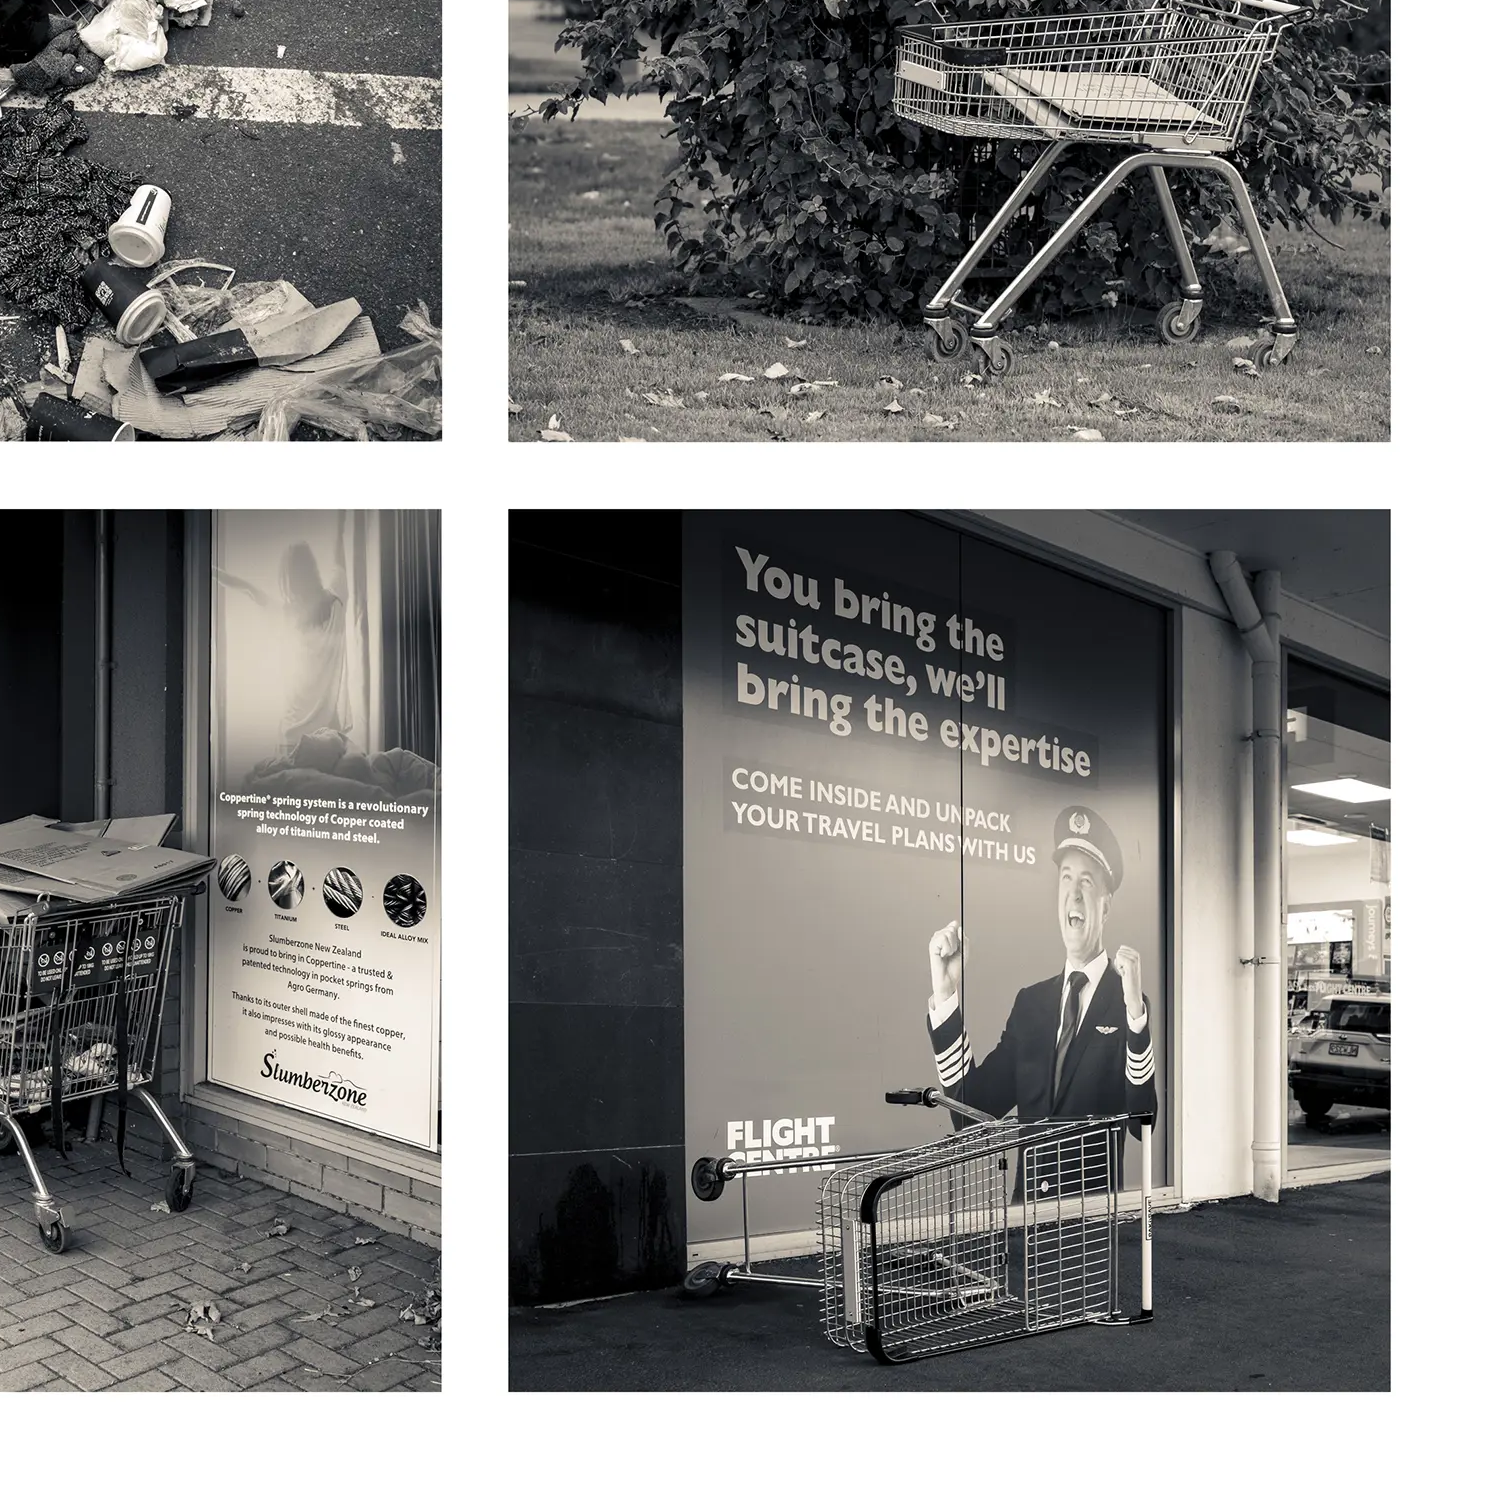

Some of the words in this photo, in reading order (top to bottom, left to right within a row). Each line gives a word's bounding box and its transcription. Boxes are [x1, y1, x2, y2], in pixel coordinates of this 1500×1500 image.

[734, 545, 821, 610] You
[833, 577, 937, 653] bring
[945, 612, 1004, 661] the
[735, 613, 918, 697] suitcase,
[737, 661, 853, 737] bring
[863, 694, 929, 742] the
[939, 718, 1091, 777] expertise
[272, 795, 301, 809] spring
[302, 798, 337, 810] system
[338, 798, 347, 809] is
[348, 801, 354, 810] a
[356, 800, 429, 818] revolutionary
[731, 767, 802, 799] COME
[809, 780, 881, 812] INSIDE
[885, 793, 930, 819] AND
[935, 802, 1012, 833] UNPACK
[237, 808, 265, 821] spring
[266, 810, 317, 825] technology
[318, 813, 329, 824] of
[330, 814, 366, 829] Copper
[368, 818, 405, 830] coated
[256, 824, 279, 836] alloy
[279, 825, 289, 836] of
[290, 826, 330, 840] titanium
[332, 830, 351, 842] and
[352, 832, 380, 844] steel.
[731, 801, 800, 832] YOUR
[802, 811, 886, 844] TRAVEL
[892, 825, 955, 854] PLANS
[957, 835, 1008, 861] WITH
[1013, 845, 1036, 865] US
[225, 906, 243, 914] COPPER
[274, 913, 298, 923] TITANIUM
[334, 923, 350, 931] STEEL
[269, 934, 314, 950] Slumberzone
[314, 943, 331, 953] New
[332, 945, 362, 959] Zealand
[380, 930, 397, 939] IDEAL
[397, 933, 416, 942] ALLOY
[417, 935, 429, 944] MIX
[242, 943, 249, 951] is
[249, 945, 269, 957] proud
[278, 950, 297, 963] bring
[297, 954, 304, 963] in
[305, 955, 346, 971] Coppertine
[357, 966, 386, 979] trusted
[386, 971, 394, 980] &
[242, 958, 271, 971] patented
[272, 964, 311, 980] technology
[311, 971, 319, 979] in
[320, 973, 345, 986] pocket
[346, 978, 373, 993] springs
[375, 983, 394, 996] from
[287, 980, 304, 994] Agro
[305, 985, 340, 1000] Germany.
[232, 991, 254, 1003] Thanks
[255, 997, 262, 1005] to
[263, 998, 272, 1007] its
[272, 1001, 291, 1012] outer
[291, 1004, 308, 1016] shell
[309, 1008, 329, 1022] made
[330, 1014, 338, 1023] of
[339, 1016, 351, 1027] the
[353, 1018, 374, 1033] finest
[375, 1026, 406, 1040] copper,
[242, 1007, 247, 1016] it
[248, 1008, 261, 1019] also
[262, 1012, 295, 1028] impresses
[296, 1021, 312, 1032] with
[312, 1024, 322, 1034] its
[322, 1027, 346, 1042] glossy
[346, 1034, 392, 1052] appearance
[264, 1027, 278, 1037] and
[278, 1031, 307, 1046] possible
[307, 1037, 331, 1051] health
[331, 1043, 364, 1060] benefits.
[260, 1050, 367, 1107] Slumberzone
[727, 1116, 836, 1150] FLIGHT
